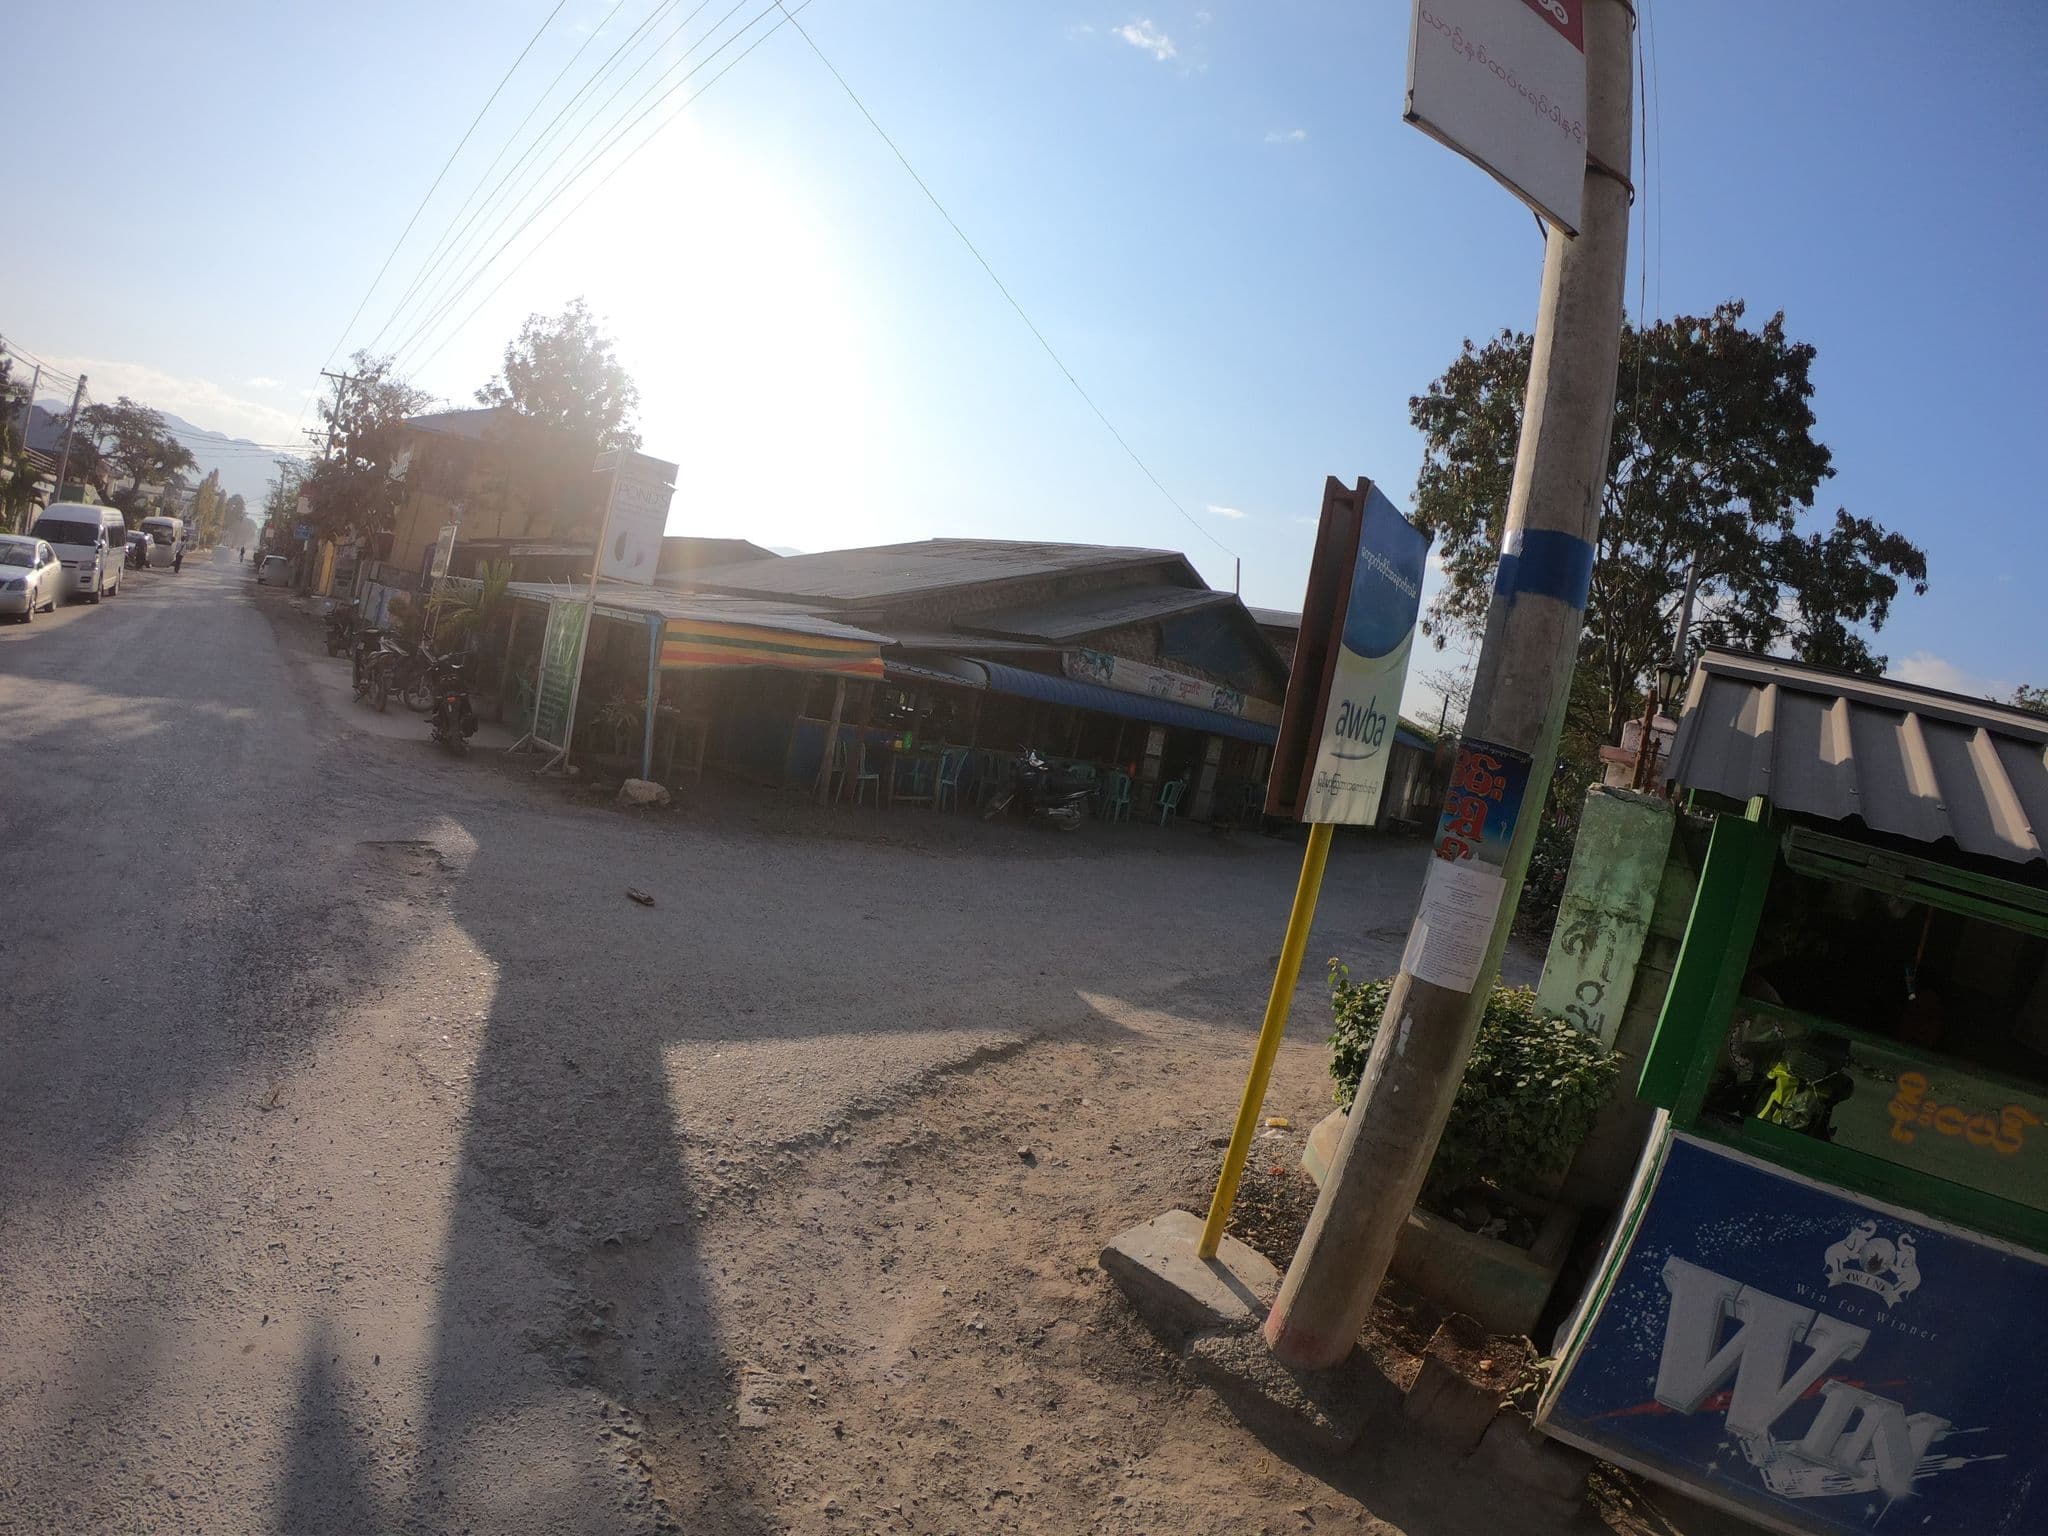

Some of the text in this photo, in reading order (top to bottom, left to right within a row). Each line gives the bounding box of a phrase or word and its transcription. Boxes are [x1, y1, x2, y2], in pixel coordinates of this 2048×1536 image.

[1335, 696, 1387, 747] awba
[1849, 1273, 1883, 1291] WIN
[1797, 1282, 1938, 1341] Win for Winner
